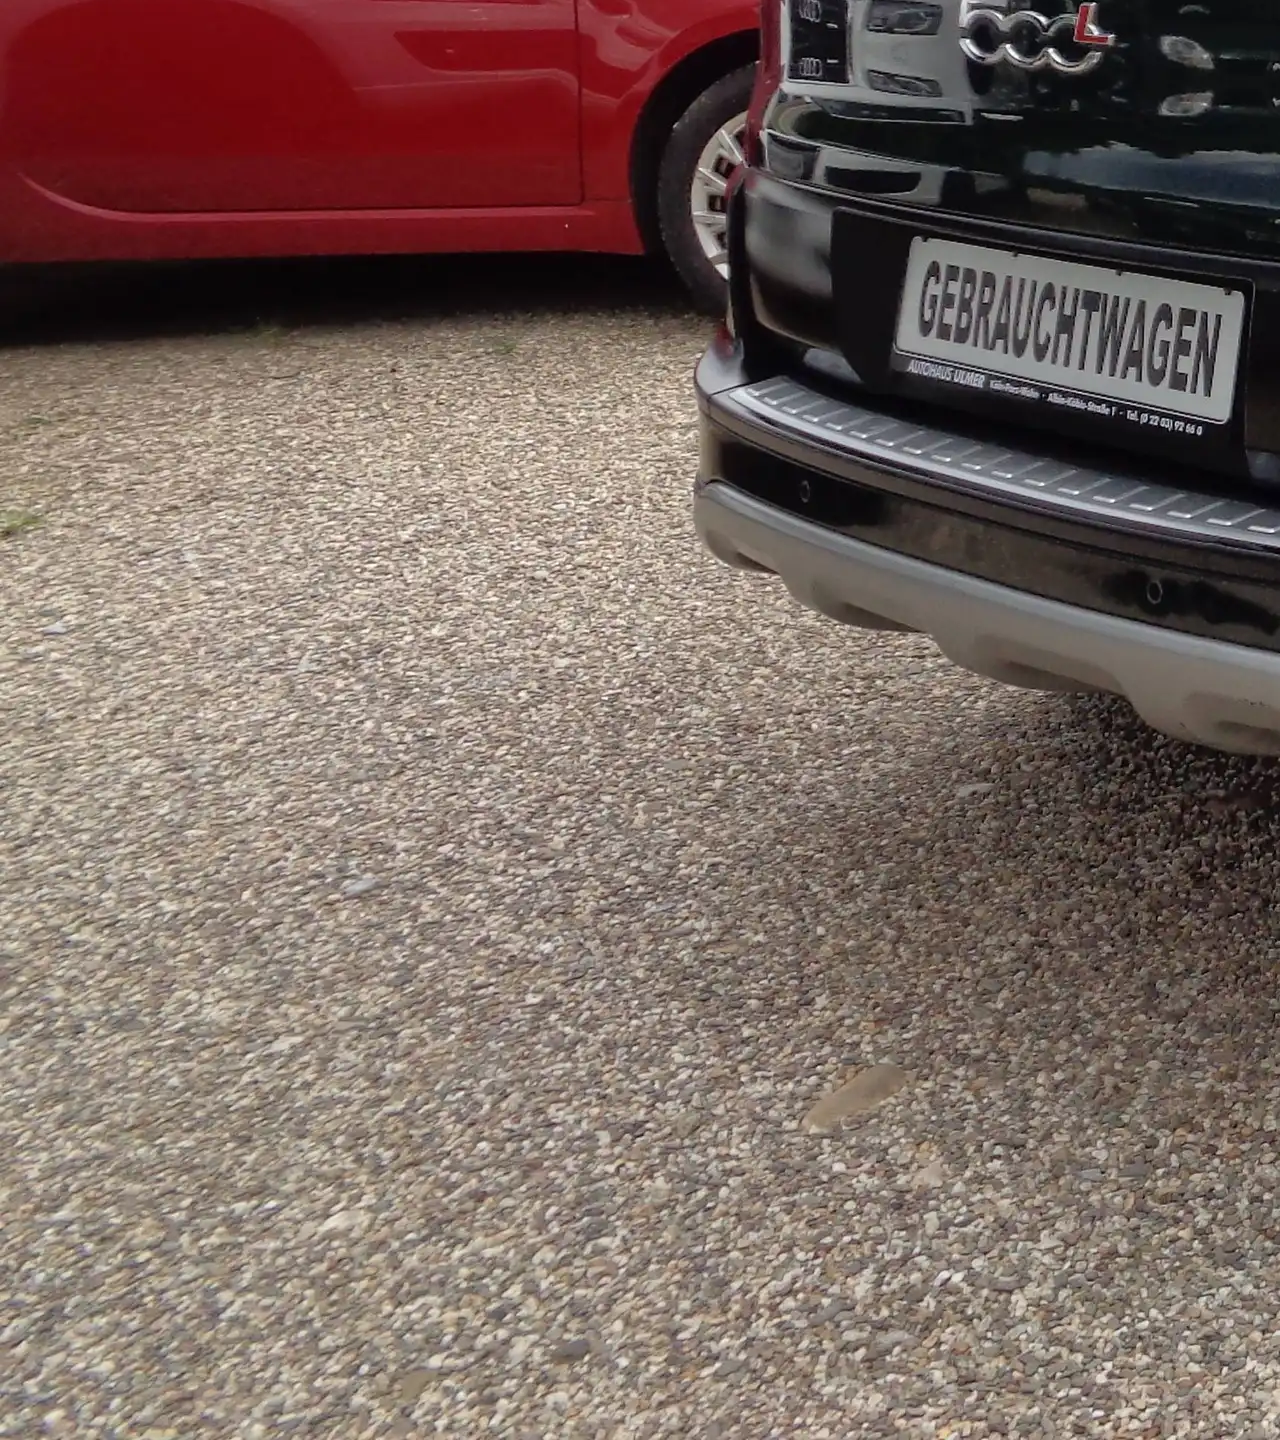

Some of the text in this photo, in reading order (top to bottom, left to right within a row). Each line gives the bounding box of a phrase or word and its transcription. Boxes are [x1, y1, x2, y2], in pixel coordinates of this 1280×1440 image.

[917, 259, 1222, 398] GEBRAUCHTWAGEN
[907, 359, 952, 382] AUTOHAUS
[953, 368, 986, 389] ULMER
